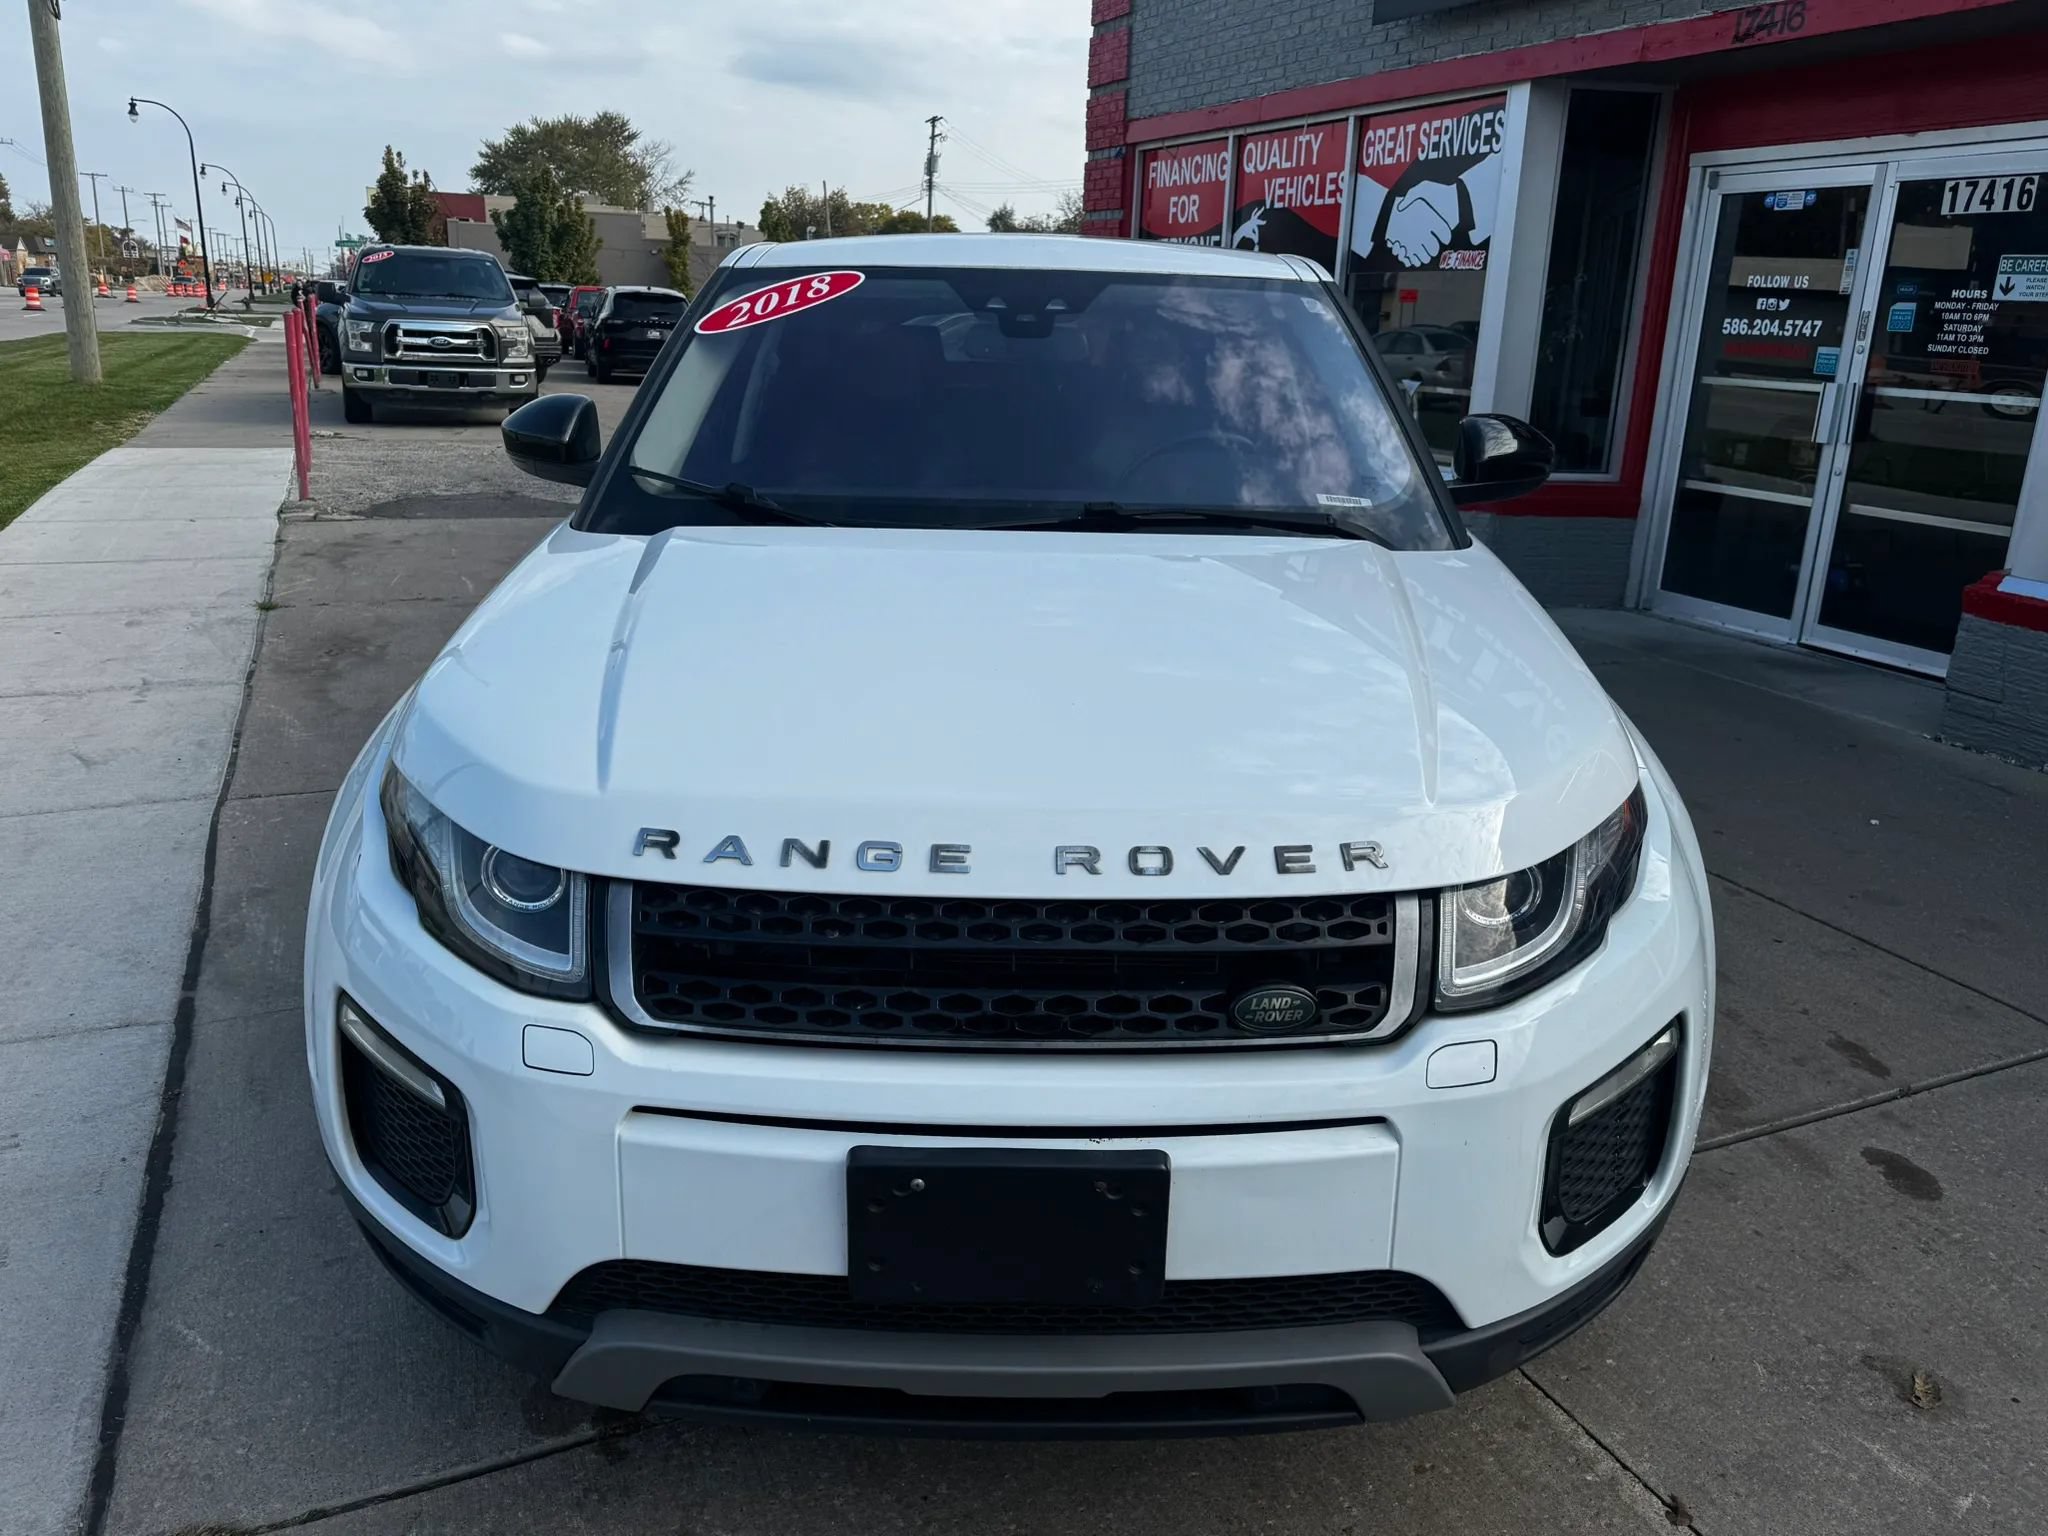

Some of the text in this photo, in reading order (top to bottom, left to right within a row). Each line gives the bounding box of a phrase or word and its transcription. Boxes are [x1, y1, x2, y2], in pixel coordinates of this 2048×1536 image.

[1362, 109, 1506, 168] GREAT SERVICES
[1242, 132, 1324, 174] QUALITY
[1148, 151, 1229, 190] FINANCING
[1264, 170, 1345, 210] VEHICLES
[1947, 176, 2036, 213] 17416
[1168, 194, 1200, 225] FOR
[1439, 250, 1486, 270] WE FINANCE
[2000, 259, 2014, 272] BE
[1747, 275, 1810, 289] FOLLOW US
[726, 275, 831, 328] 2018
[1951, 289, 1989, 299] HOURS
[1934, 302, 1966, 310] MONDAY
[1971, 302, 2000, 311] FRIDAY
[1941, 312, 1961, 320] 10AM
[1721, 318, 1824, 338] 586.204.5747
[1943, 323, 1983, 333] SATURDAY
[1936, 333, 1985, 343] 11AM TO 3PM
[1927, 344, 1990, 355] SUNDAY CLOSED
[631, 826, 1390, 877] RANGE ROVER
[1250, 998, 1292, 1010] LAND
[1254, 1010, 1304, 1022] ROVER
